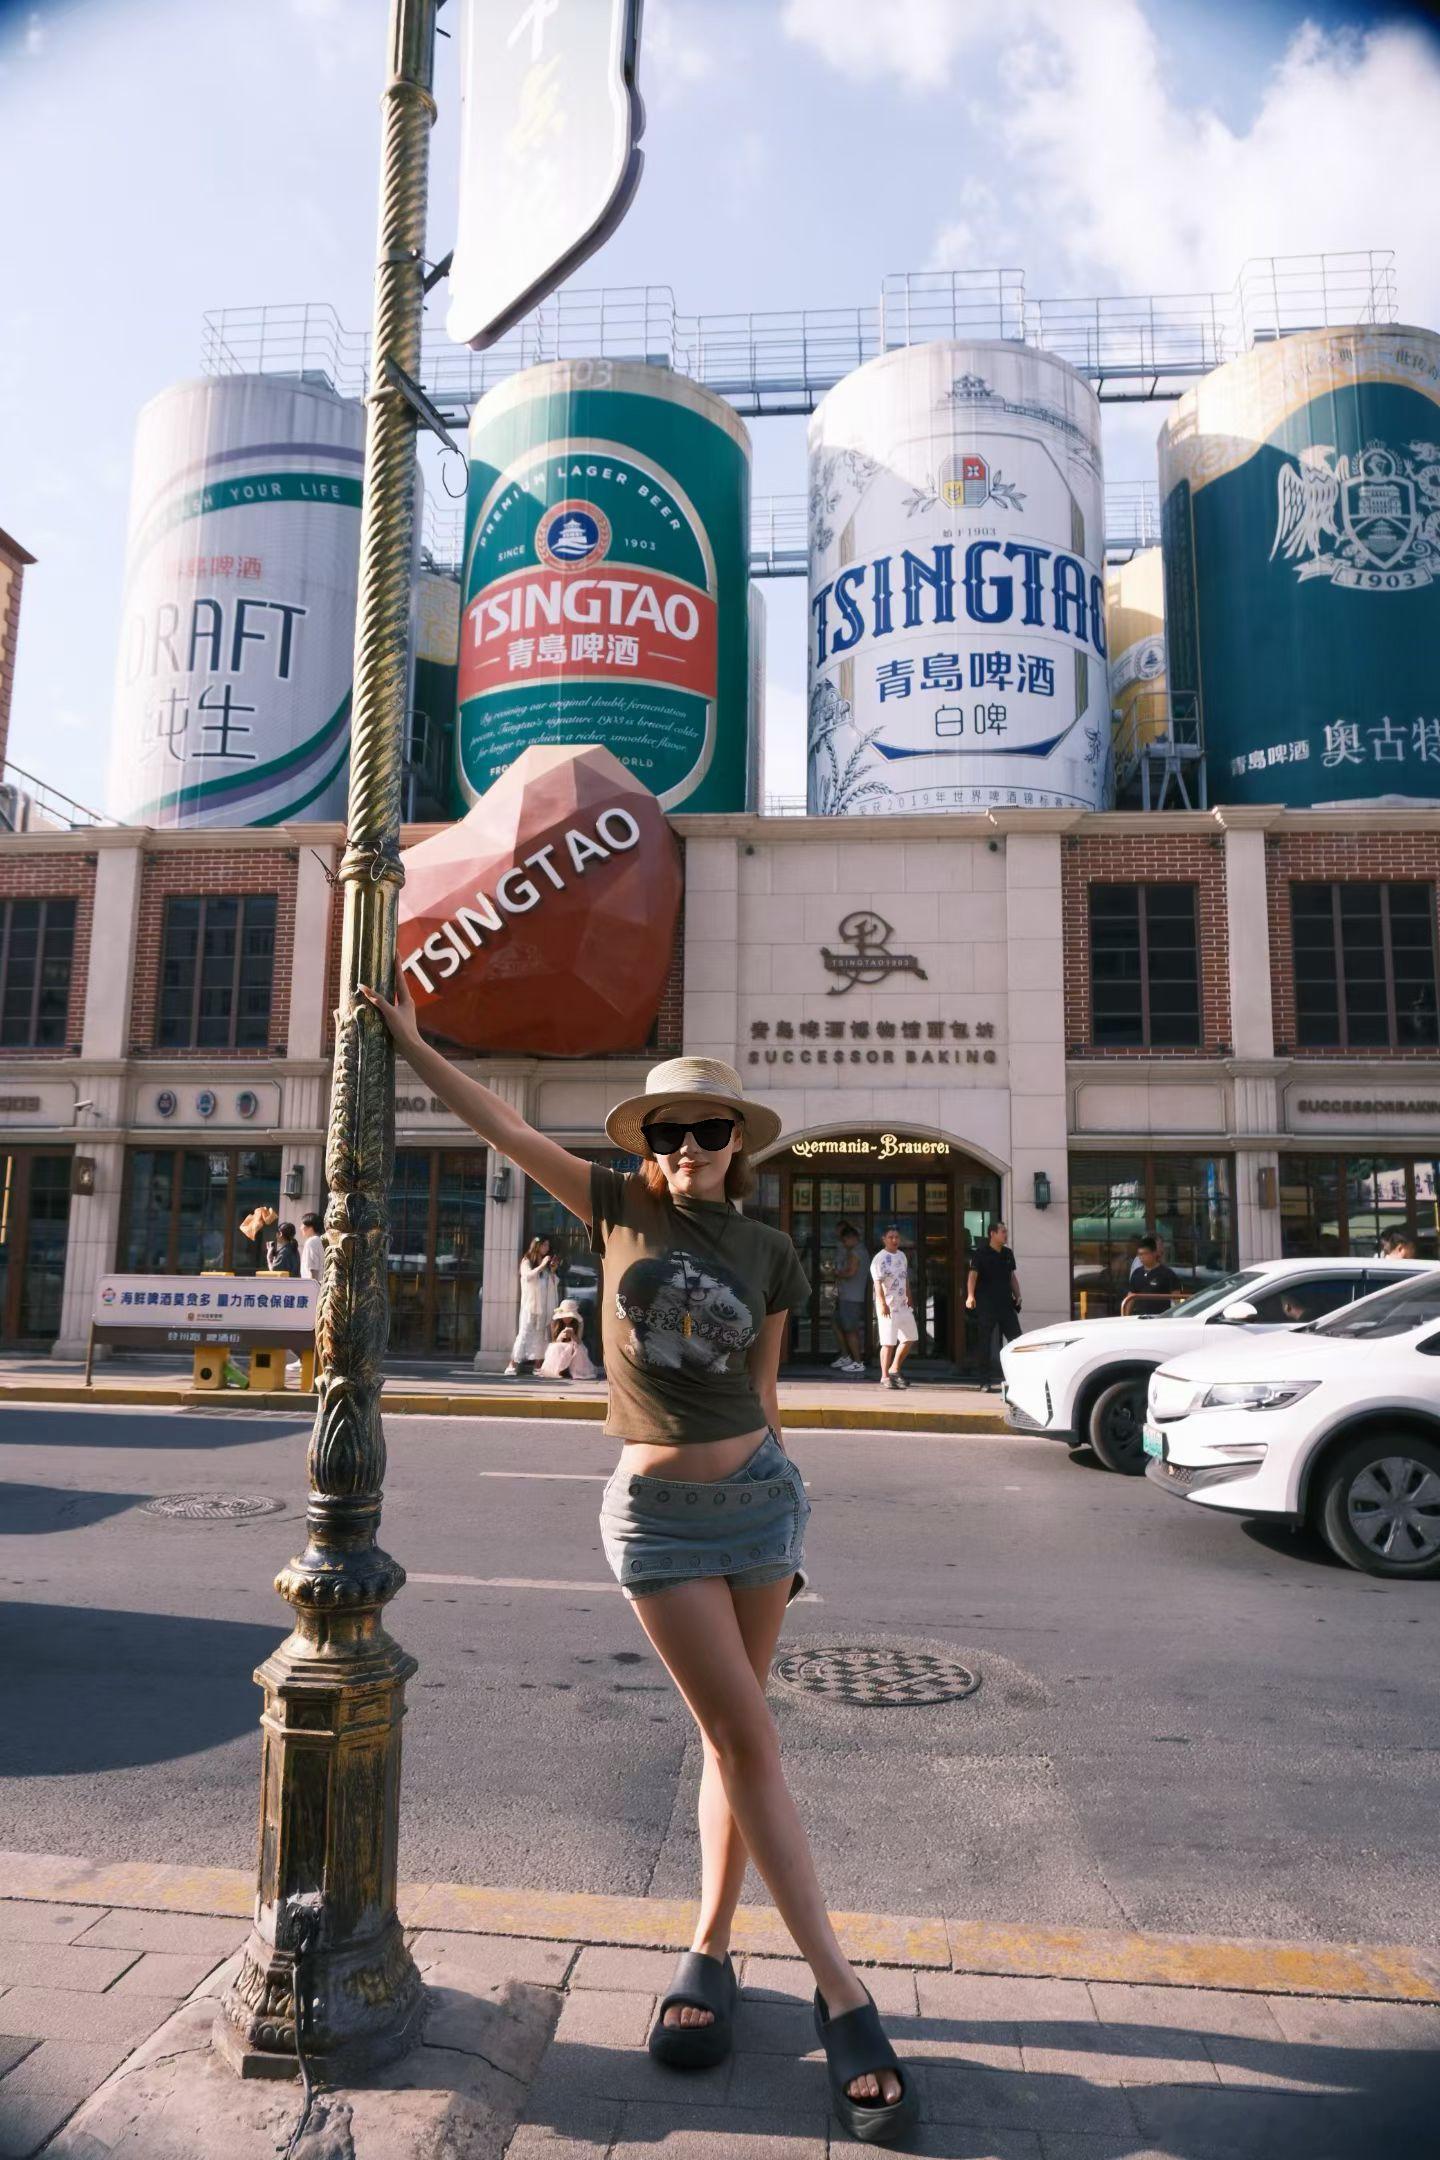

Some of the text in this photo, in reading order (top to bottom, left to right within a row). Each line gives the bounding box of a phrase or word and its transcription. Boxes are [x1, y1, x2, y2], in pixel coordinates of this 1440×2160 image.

[229, 483, 341, 500] YOUR LIFE
[480, 465, 681, 548] PREMIUM LAGER BEER
[498, 544, 525, 562] SINCE
[624, 538, 656, 551] 1903
[1353, 572, 1416, 588] 1903
[469, 580, 699, 648] TSINGTAO
[127, 598, 306, 683] DRAFT
[507, 632, 640, 671] 青島啤酒
[875, 650, 1055, 703] 青島啤酒
[934, 702, 1008, 737] 白啤
[489, 755, 654, 777] FRO ORLD
[1230, 739, 1310, 777] 青島啤酒
[401, 807, 641, 994] TSINGTAO
[748, 1050, 997, 1065] SUCCESSOR BAKING
[217, 1294, 309, 1309] 量力而食保健康
